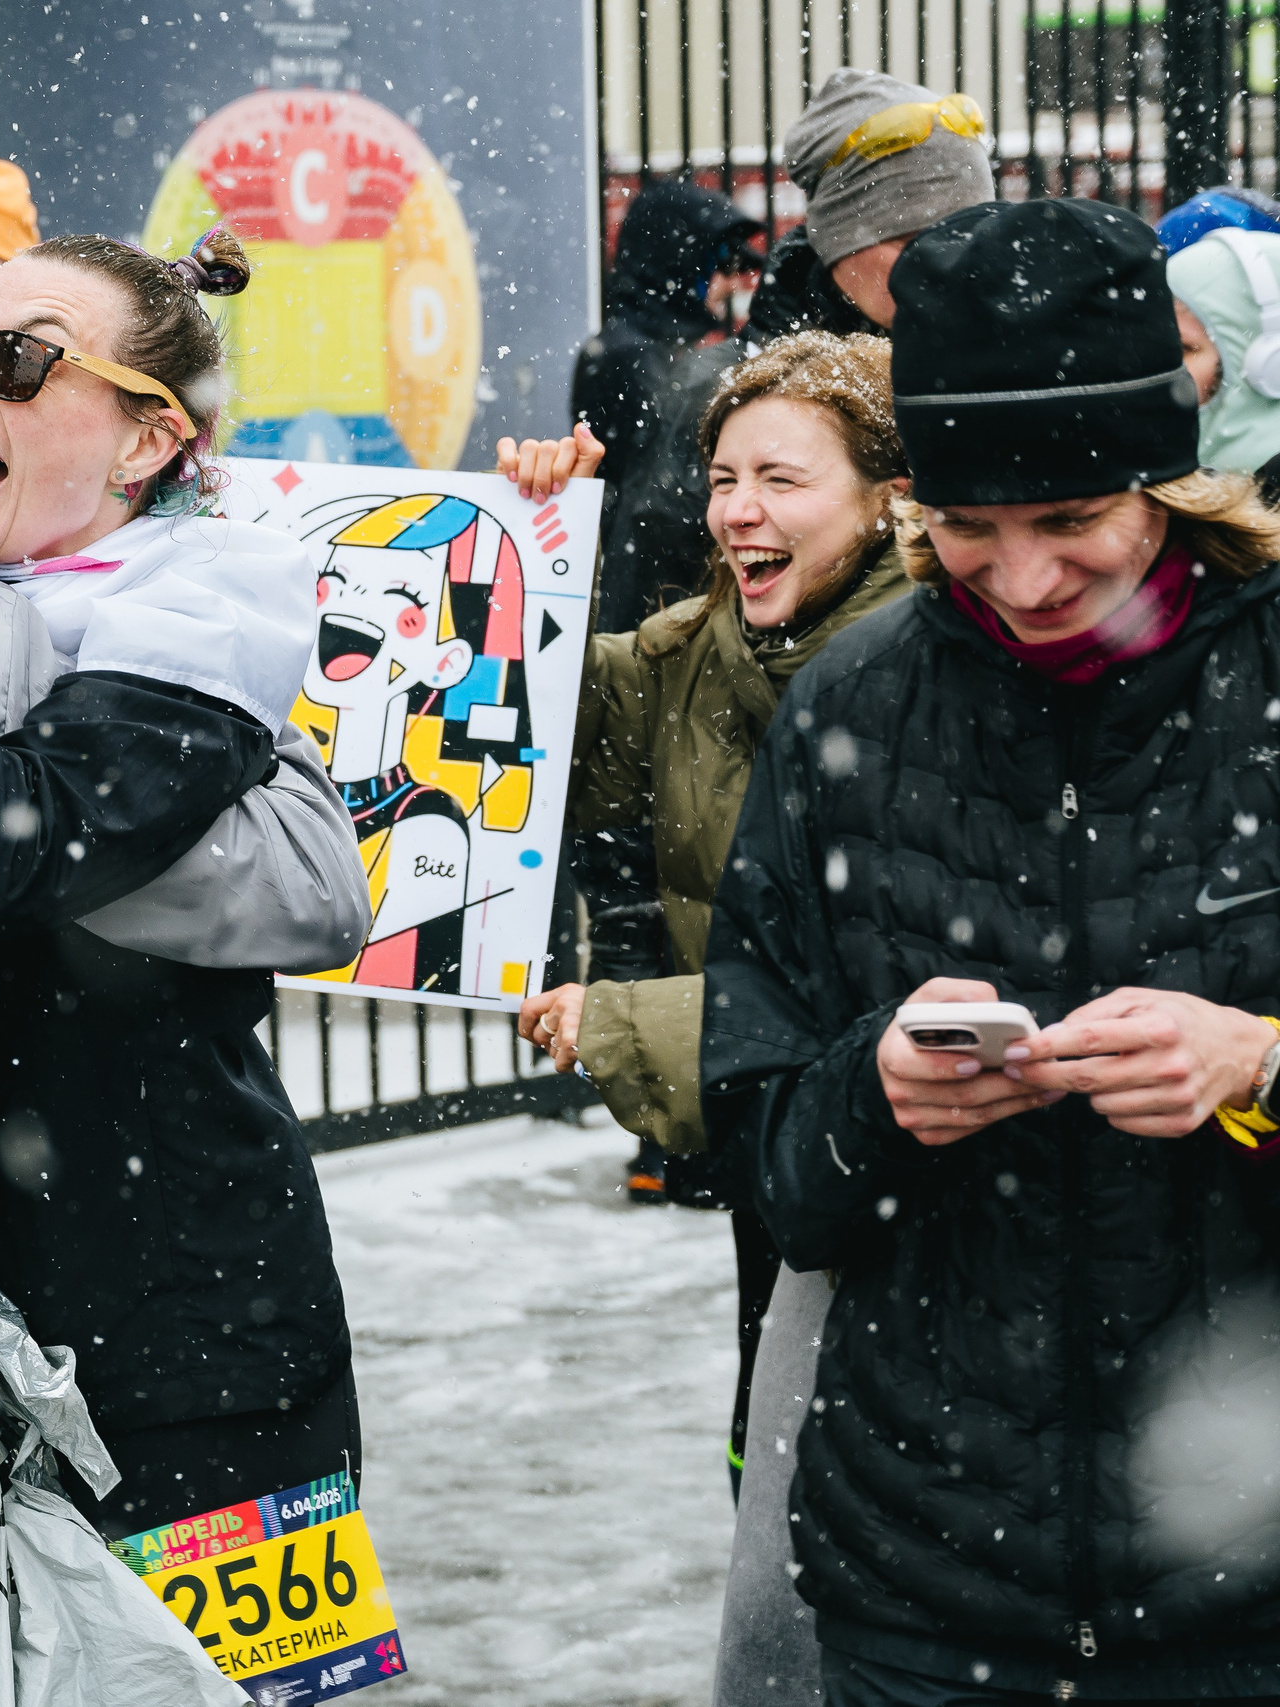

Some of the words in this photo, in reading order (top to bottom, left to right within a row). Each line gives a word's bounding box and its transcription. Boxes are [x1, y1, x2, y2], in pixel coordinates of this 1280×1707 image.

[408, 286, 447, 357] D
[414, 855, 456, 878] Bite
[280, 1487, 342, 1520] 6.04.2025
[141, 1511, 244, 1556] АПРЕЛЬ
[144, 1548, 194, 1574] забег
[210, 1538, 223, 1554] 5
[227, 1534, 250, 1550] км
[162, 1529, 357, 1649] 2566
[213, 1618, 349, 1676] ЕКАТЕРИНА
